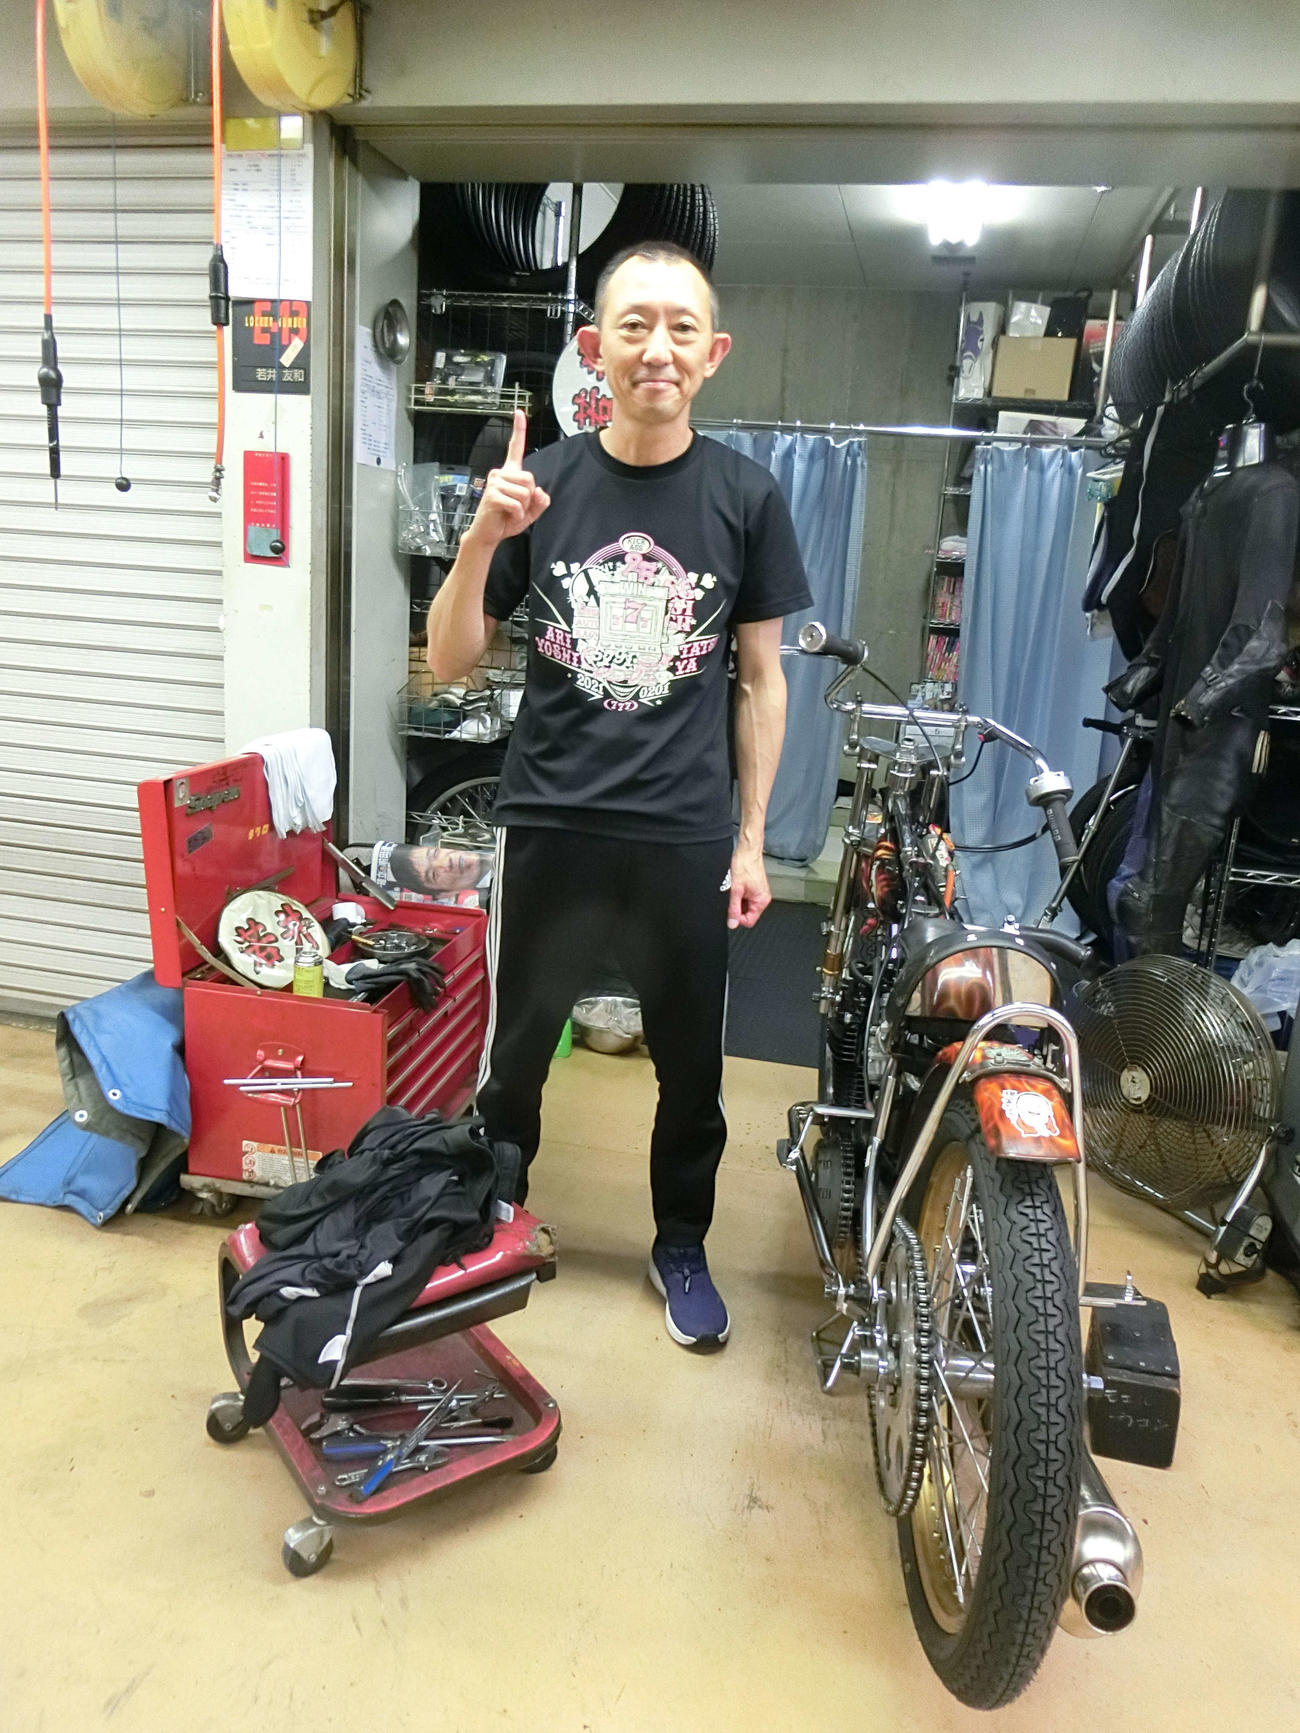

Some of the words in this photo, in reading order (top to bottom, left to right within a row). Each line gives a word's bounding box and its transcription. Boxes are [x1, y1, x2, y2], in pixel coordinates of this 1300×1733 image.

[255, 367, 277, 382] 若井
[282, 368, 305, 383] 友和
[545, 626, 573, 649] ARI
[534, 636, 581, 668] YOSHI
[675, 656, 698, 676] YA
[575, 673, 604, 696] 2021
[639, 682, 671, 699] 0201
